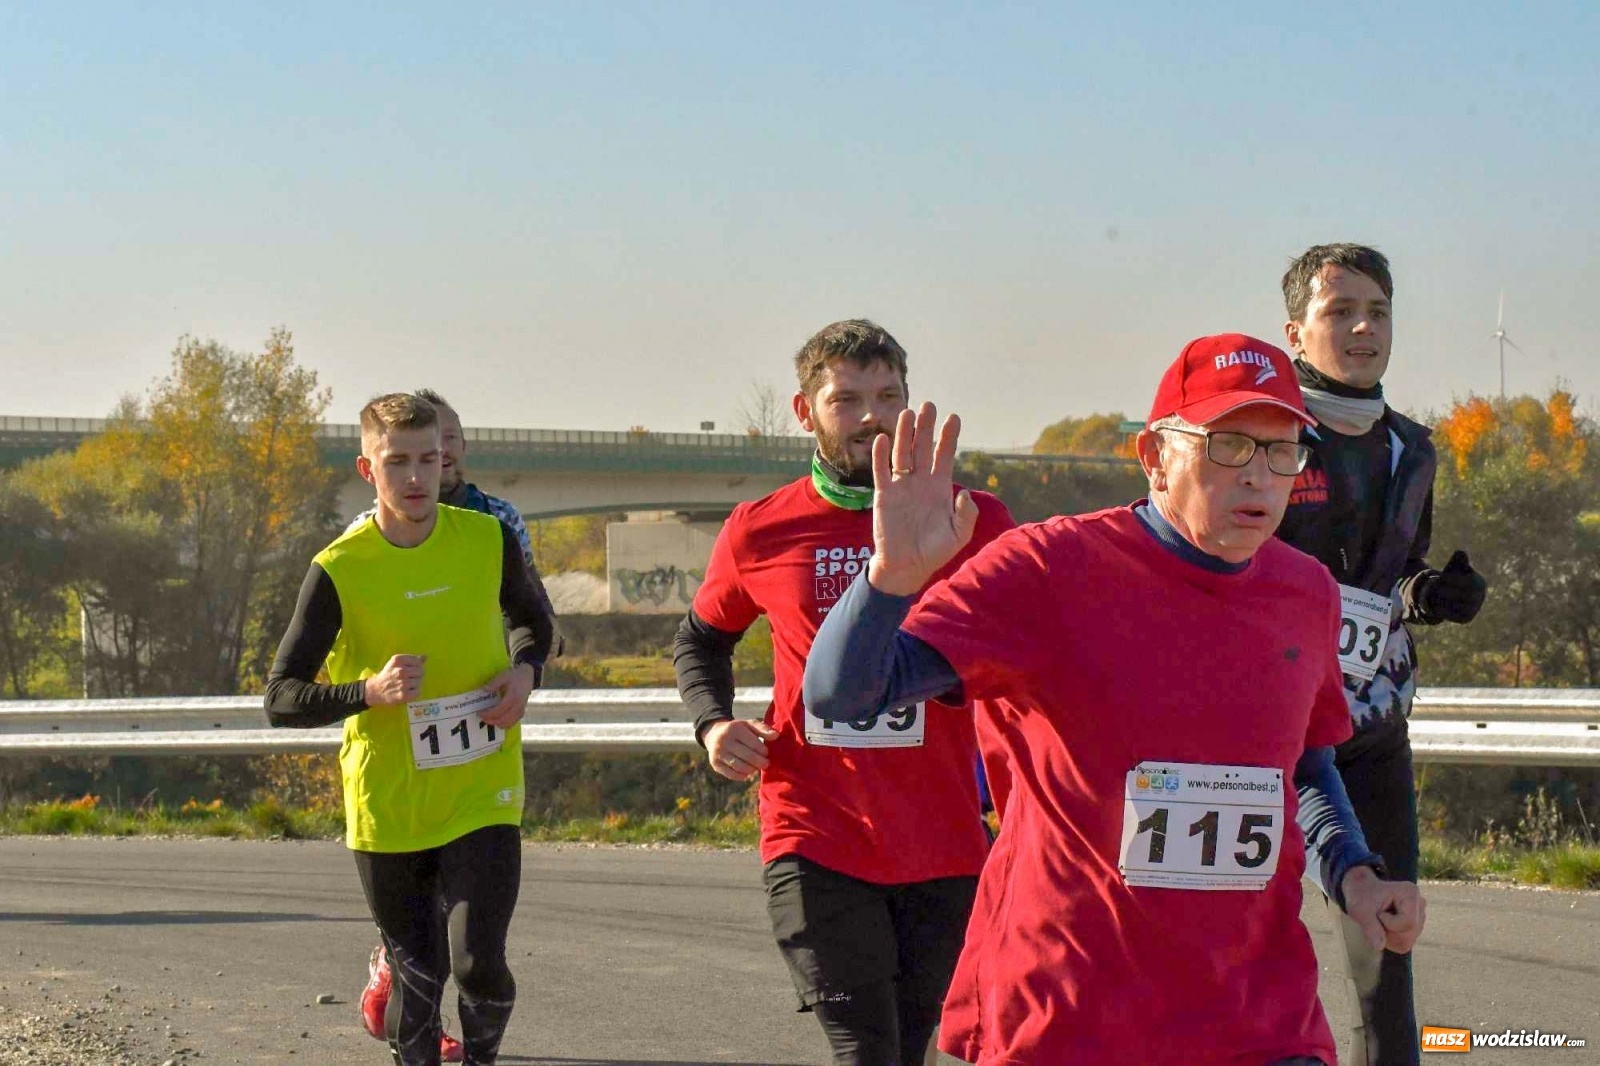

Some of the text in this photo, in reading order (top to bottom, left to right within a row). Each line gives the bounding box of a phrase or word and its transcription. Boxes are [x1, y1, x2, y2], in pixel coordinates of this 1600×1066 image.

[1215, 351, 1272, 370] RAUCH
[815, 560, 868, 577] SPO
[815, 576, 856, 600] RU
[1341, 595, 1389, 614] ww.personalbest.pl
[419, 718, 496, 756] 111
[1136, 766, 1180, 775] PrsonaBest
[1187, 779, 1279, 794] www.personalbest.pl
[1137, 808, 1273, 868] 115
